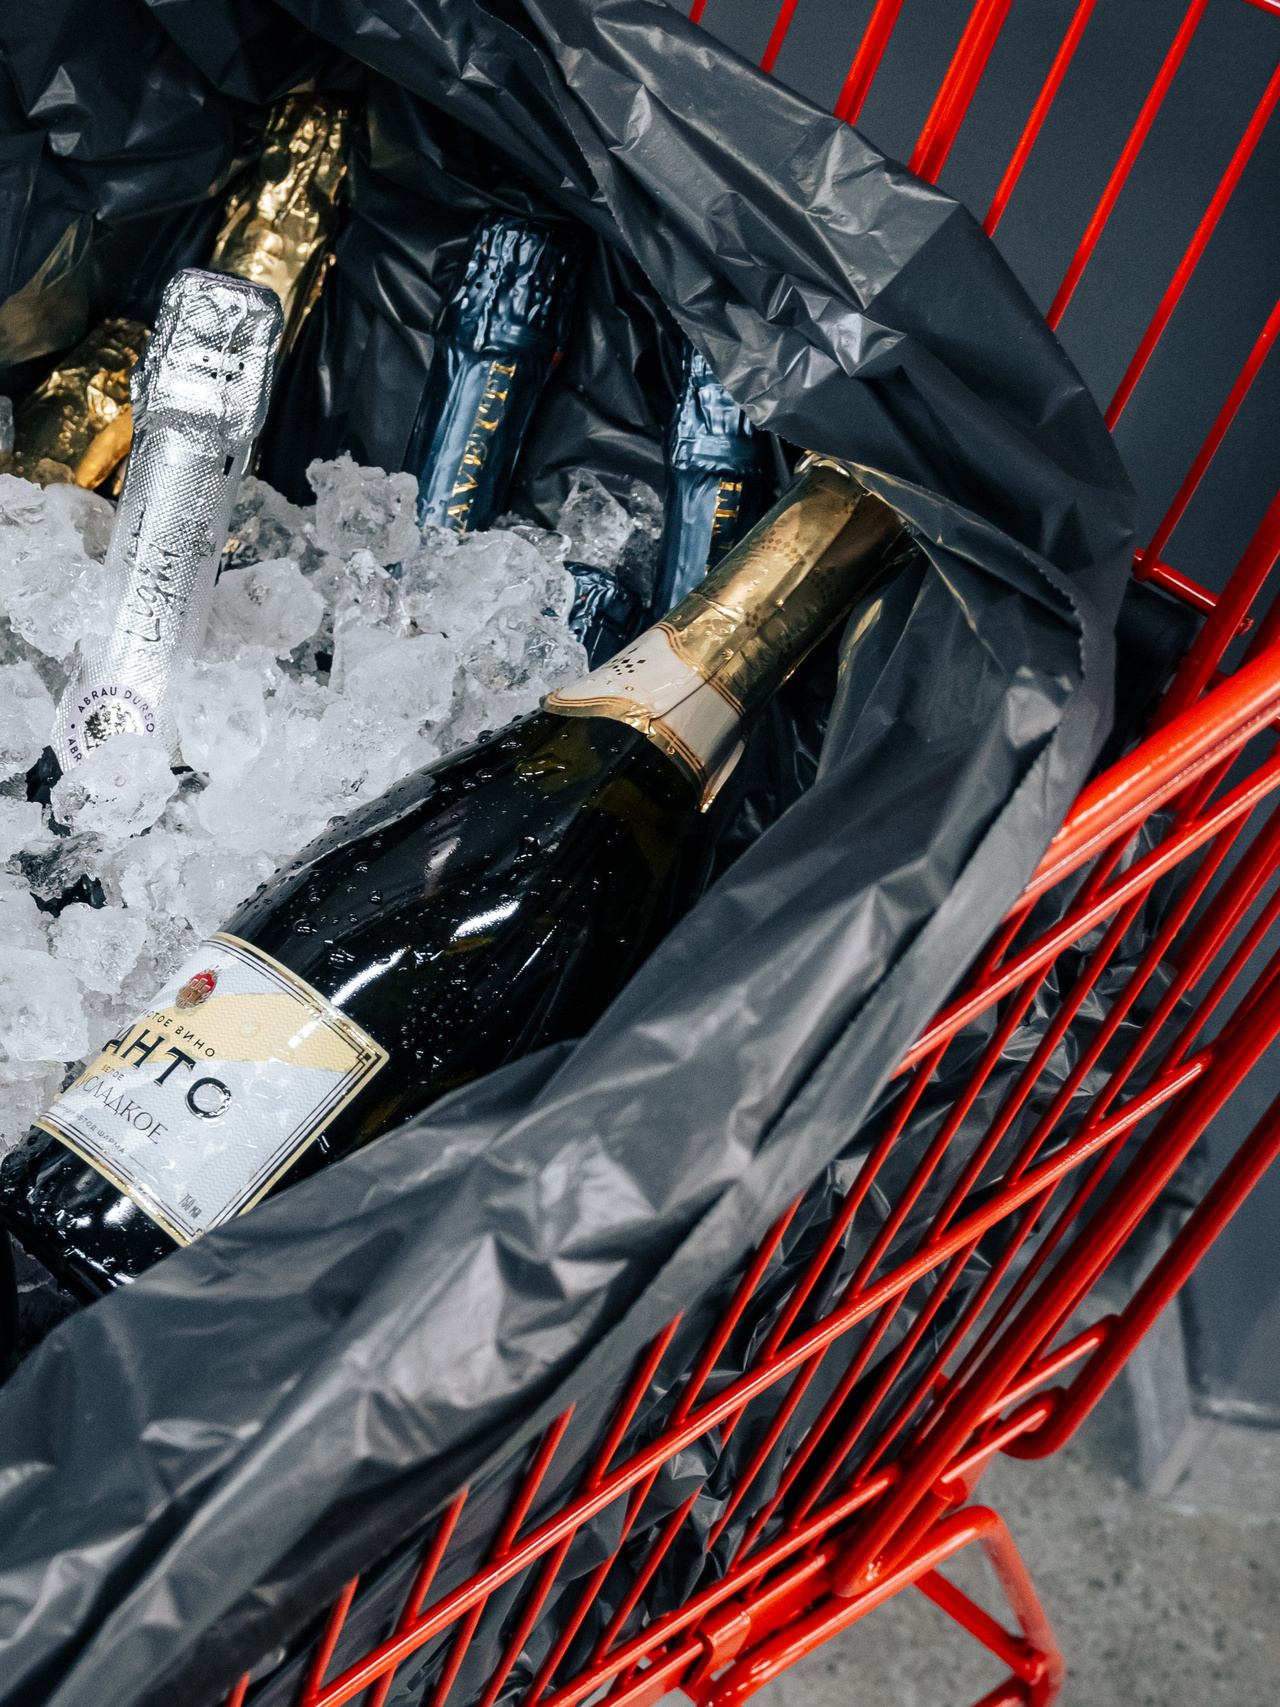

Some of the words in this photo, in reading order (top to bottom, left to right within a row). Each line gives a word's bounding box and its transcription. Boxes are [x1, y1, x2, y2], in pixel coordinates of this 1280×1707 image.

[78, 686, 118, 713] ABRAU
[123, 690, 155, 733] DURSO
[67, 738, 83, 765] ABR
[175, 1026, 216, 1058] ВИНО
